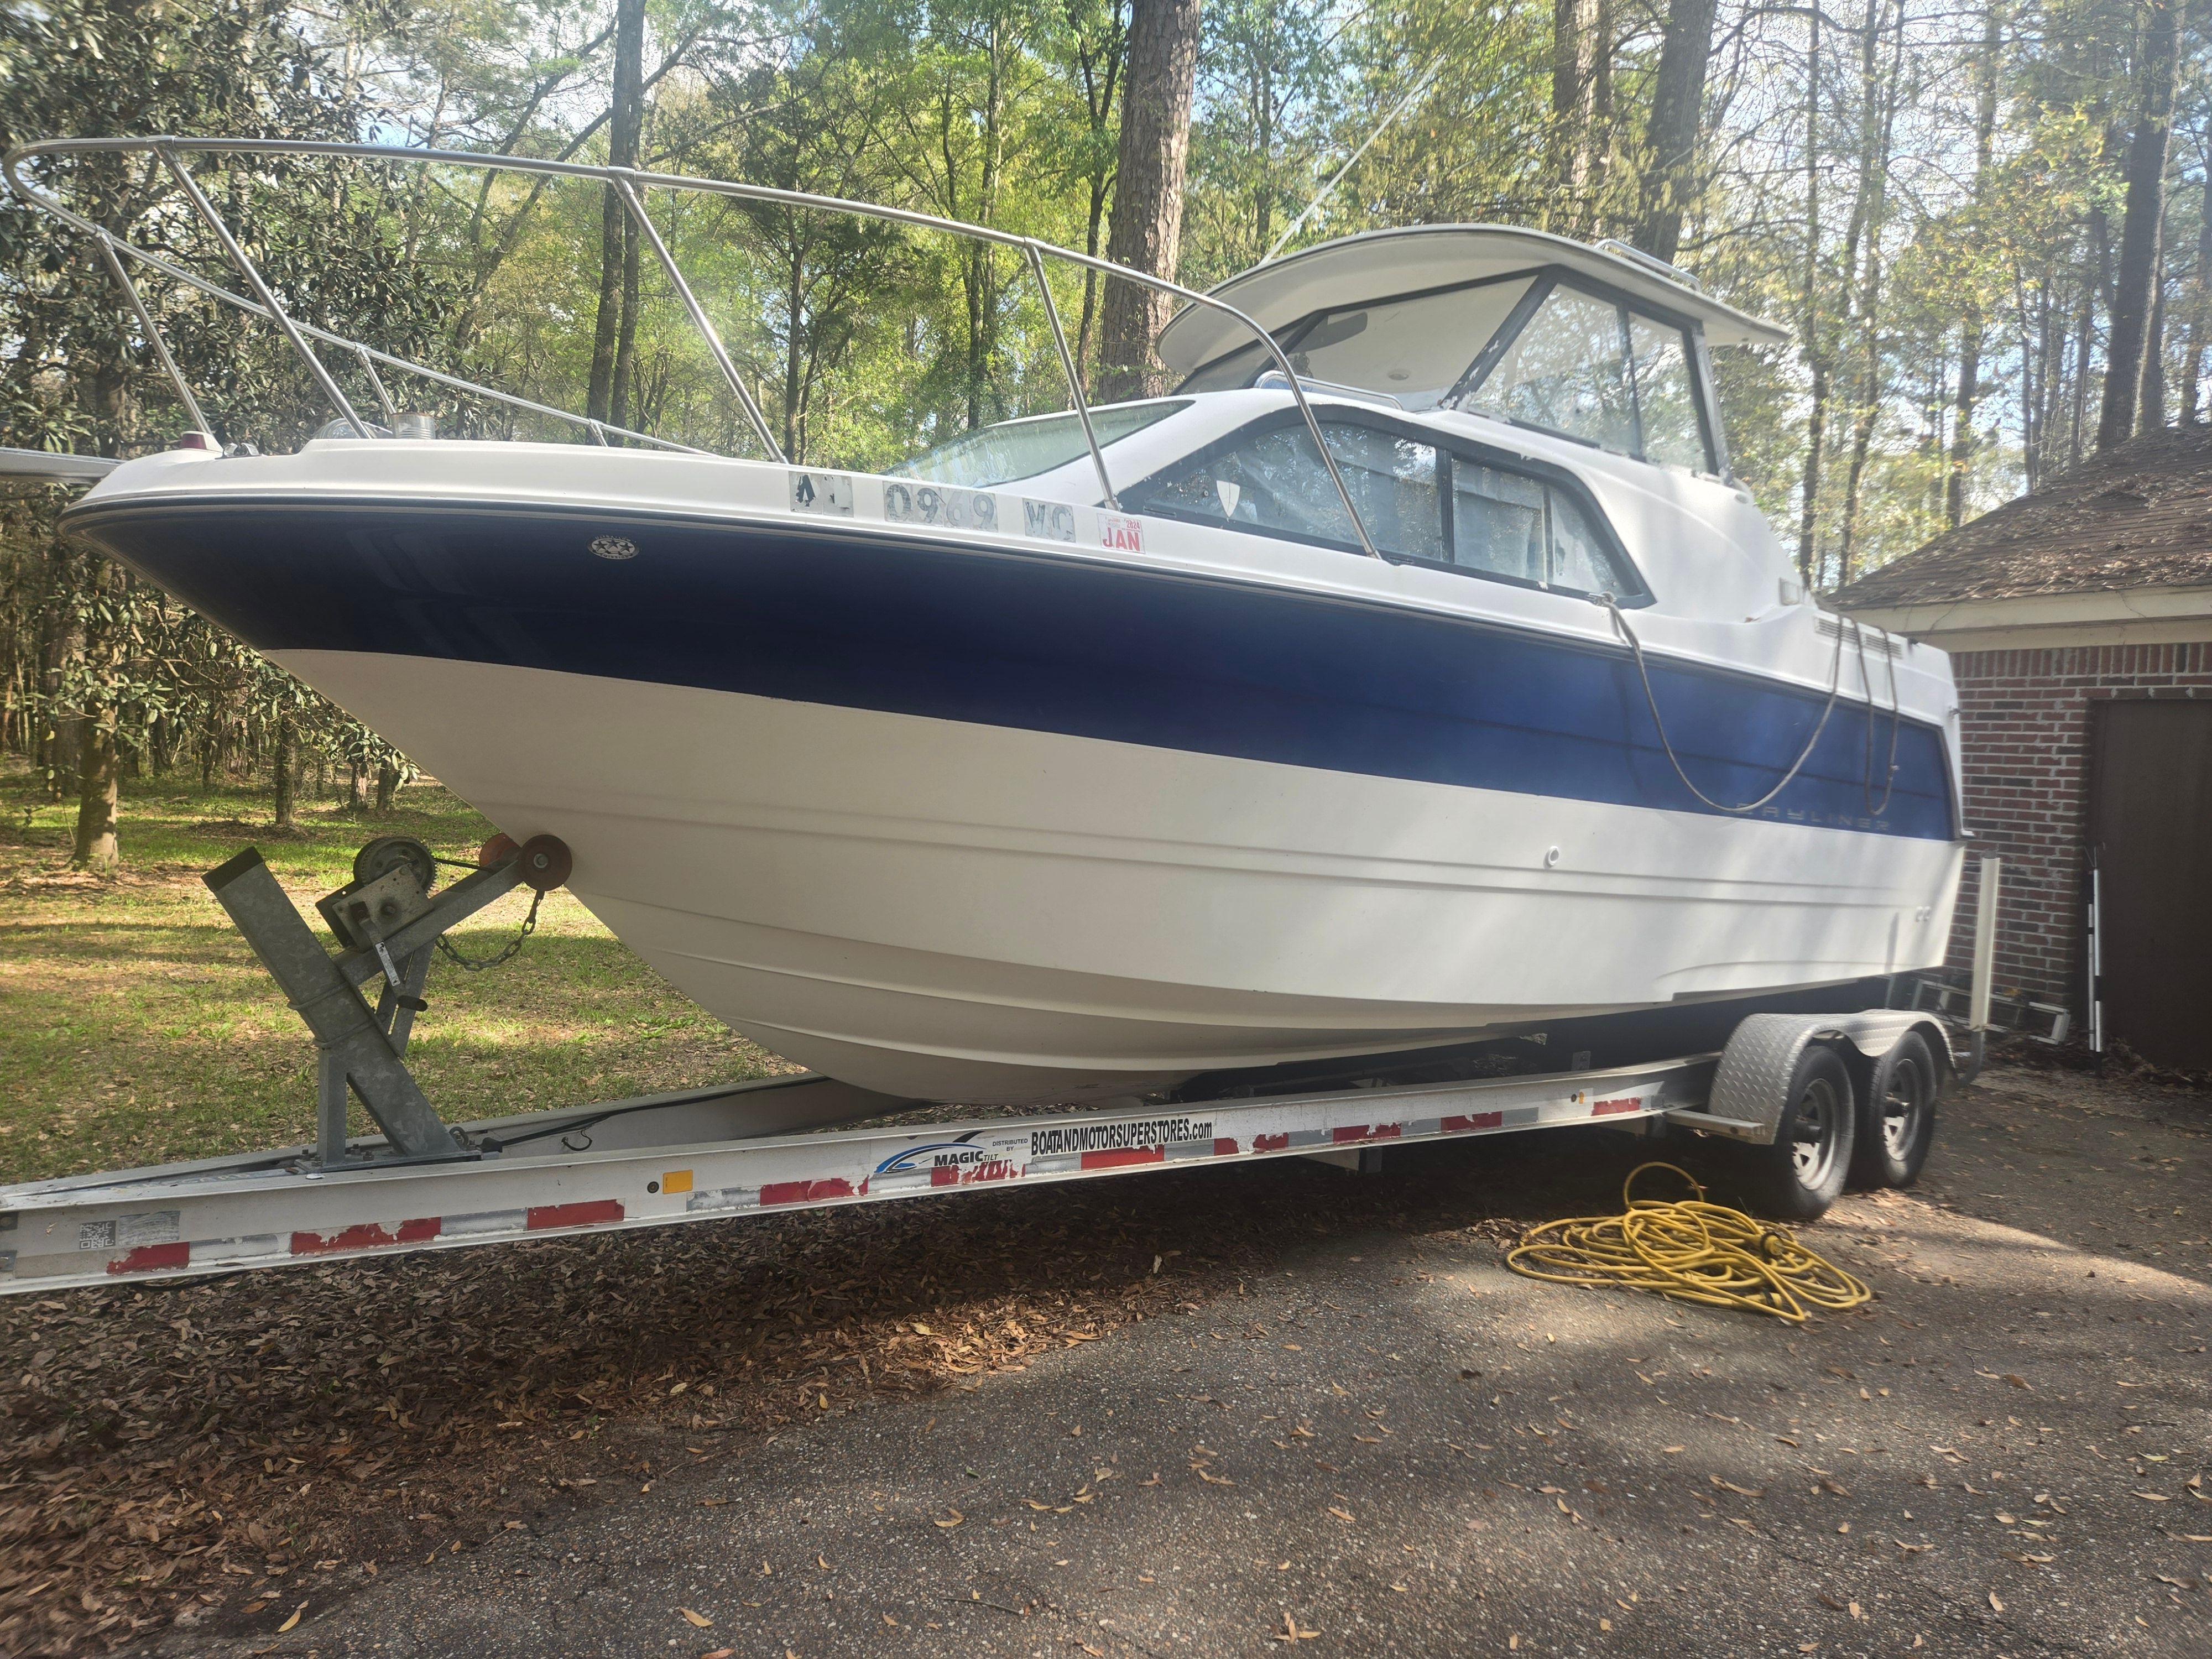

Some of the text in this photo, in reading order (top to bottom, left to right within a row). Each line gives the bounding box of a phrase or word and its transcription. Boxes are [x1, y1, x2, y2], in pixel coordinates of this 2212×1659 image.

[1125, 519, 1140, 529] 2024
[1102, 526, 1140, 552] JAN
[992, 1138, 1028, 1146] DISTRIBUTED
[1031, 1118, 1212, 1155] BOATANDMOTORSUPERSTORES.com
[934, 1150, 983, 1166] MAGIC
